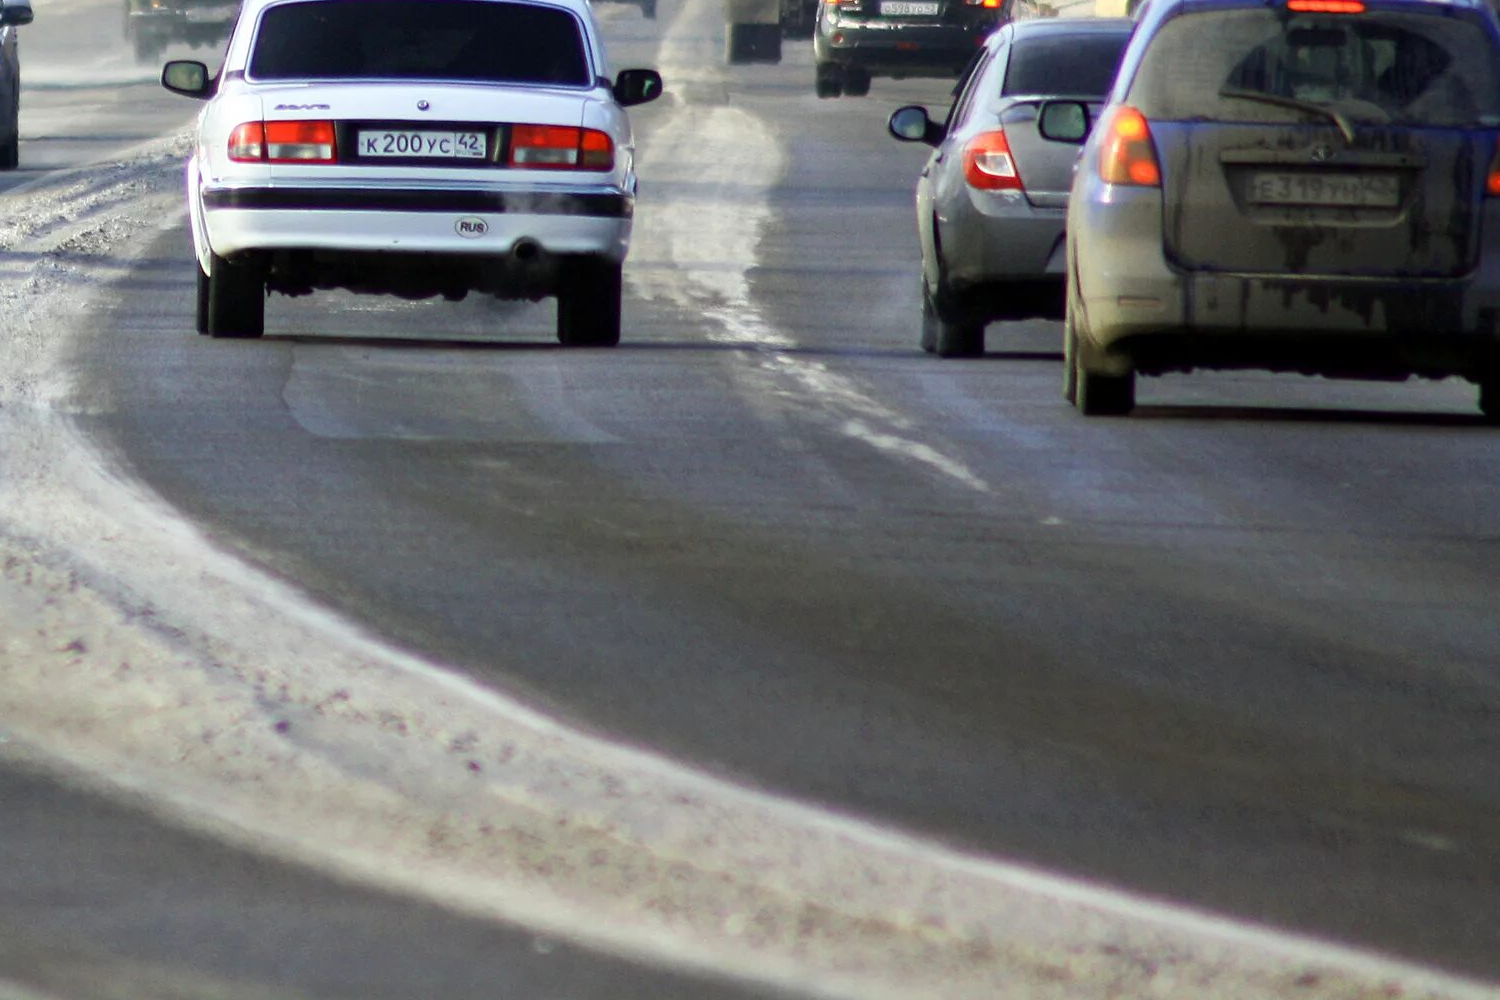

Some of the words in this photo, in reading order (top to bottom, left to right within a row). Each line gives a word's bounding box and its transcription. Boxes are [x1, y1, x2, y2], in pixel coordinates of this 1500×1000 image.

[366, 133, 451, 154] К200УС
[458, 133, 479, 150] 42
[460, 222, 484, 233] RUS
